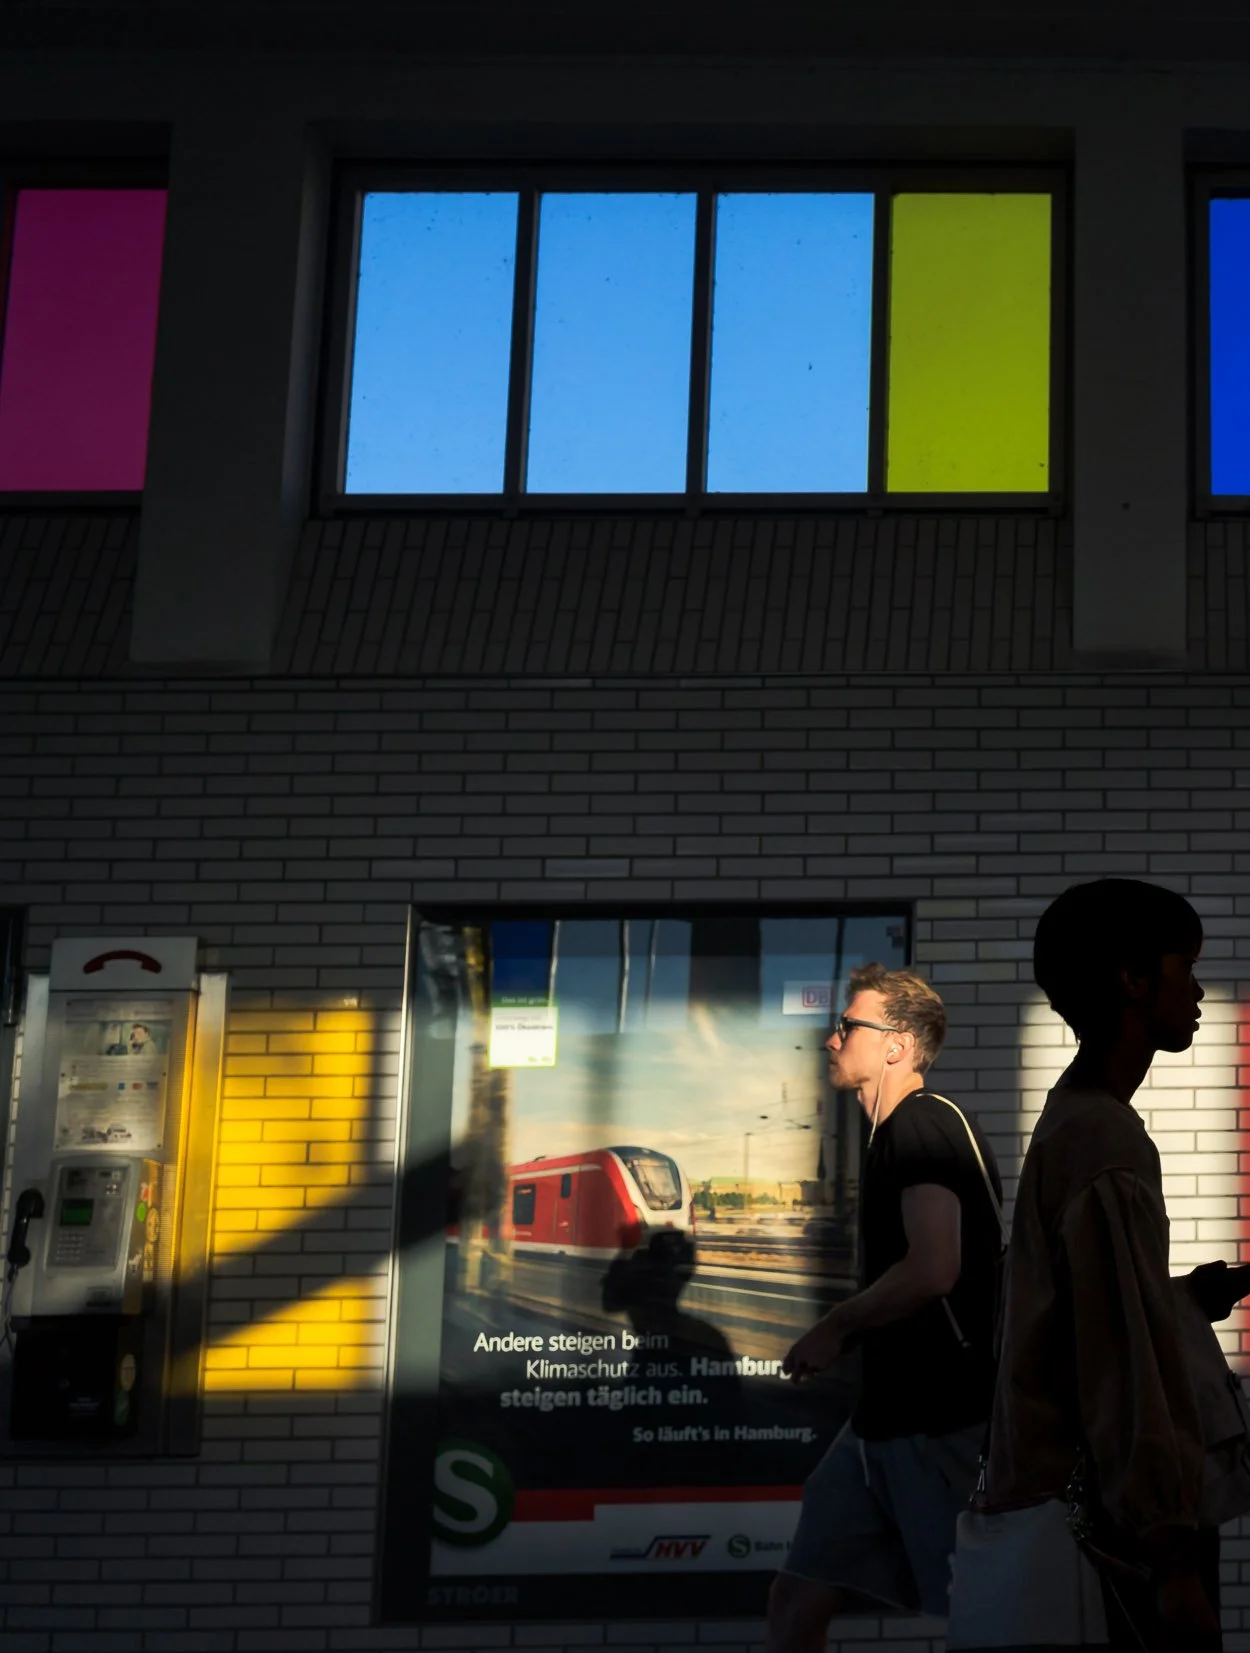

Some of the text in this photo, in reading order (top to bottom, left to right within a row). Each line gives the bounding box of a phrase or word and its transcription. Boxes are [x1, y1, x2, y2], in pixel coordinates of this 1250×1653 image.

[474, 1329, 669, 1356] Andere steigen beim
[526, 1359, 641, 1379] Klimaschutz
[646, 1361, 683, 1377] aus.
[500, 1386, 709, 1412] steigen täglich ein.
[632, 1424, 817, 1444] So läuft's in Hamburg.
[433, 1449, 498, 1534] S
[655, 1540, 707, 1560] HVV
[755, 1540, 783, 1552] Bahn
